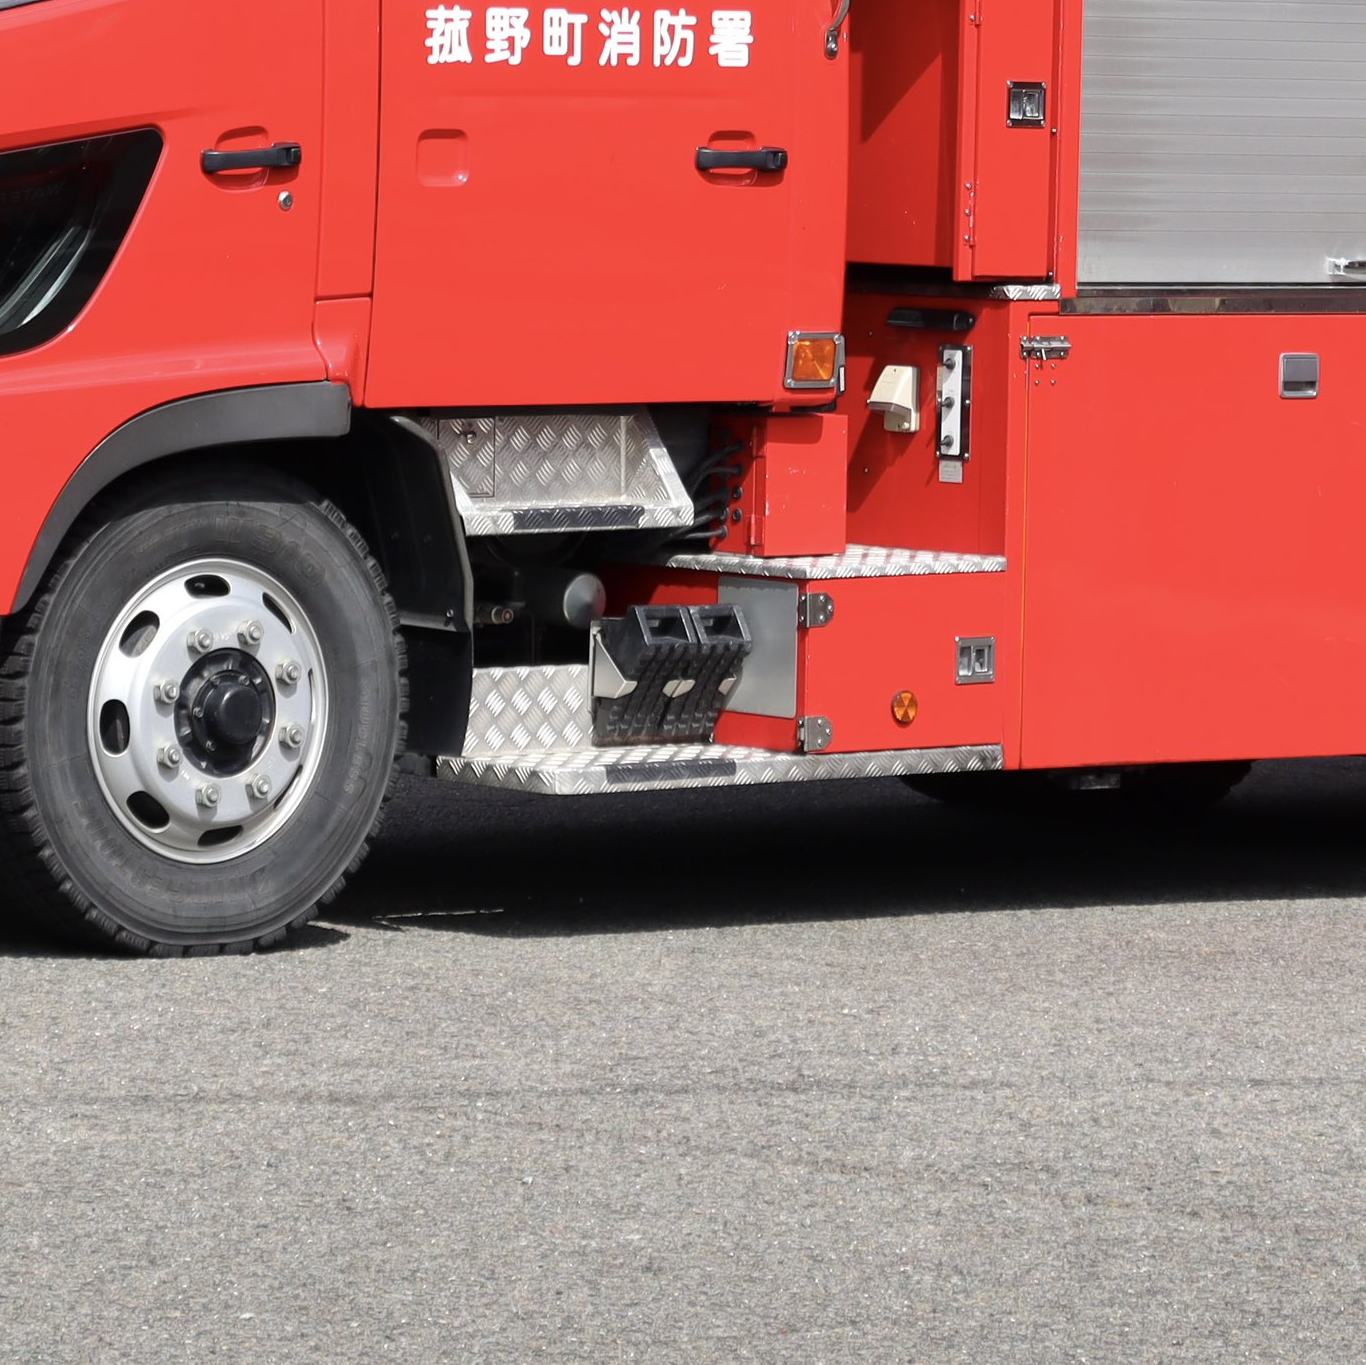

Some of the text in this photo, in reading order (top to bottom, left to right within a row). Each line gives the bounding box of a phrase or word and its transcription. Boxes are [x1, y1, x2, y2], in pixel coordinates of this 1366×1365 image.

[424, 4, 755, 68] 菰野町消防署
